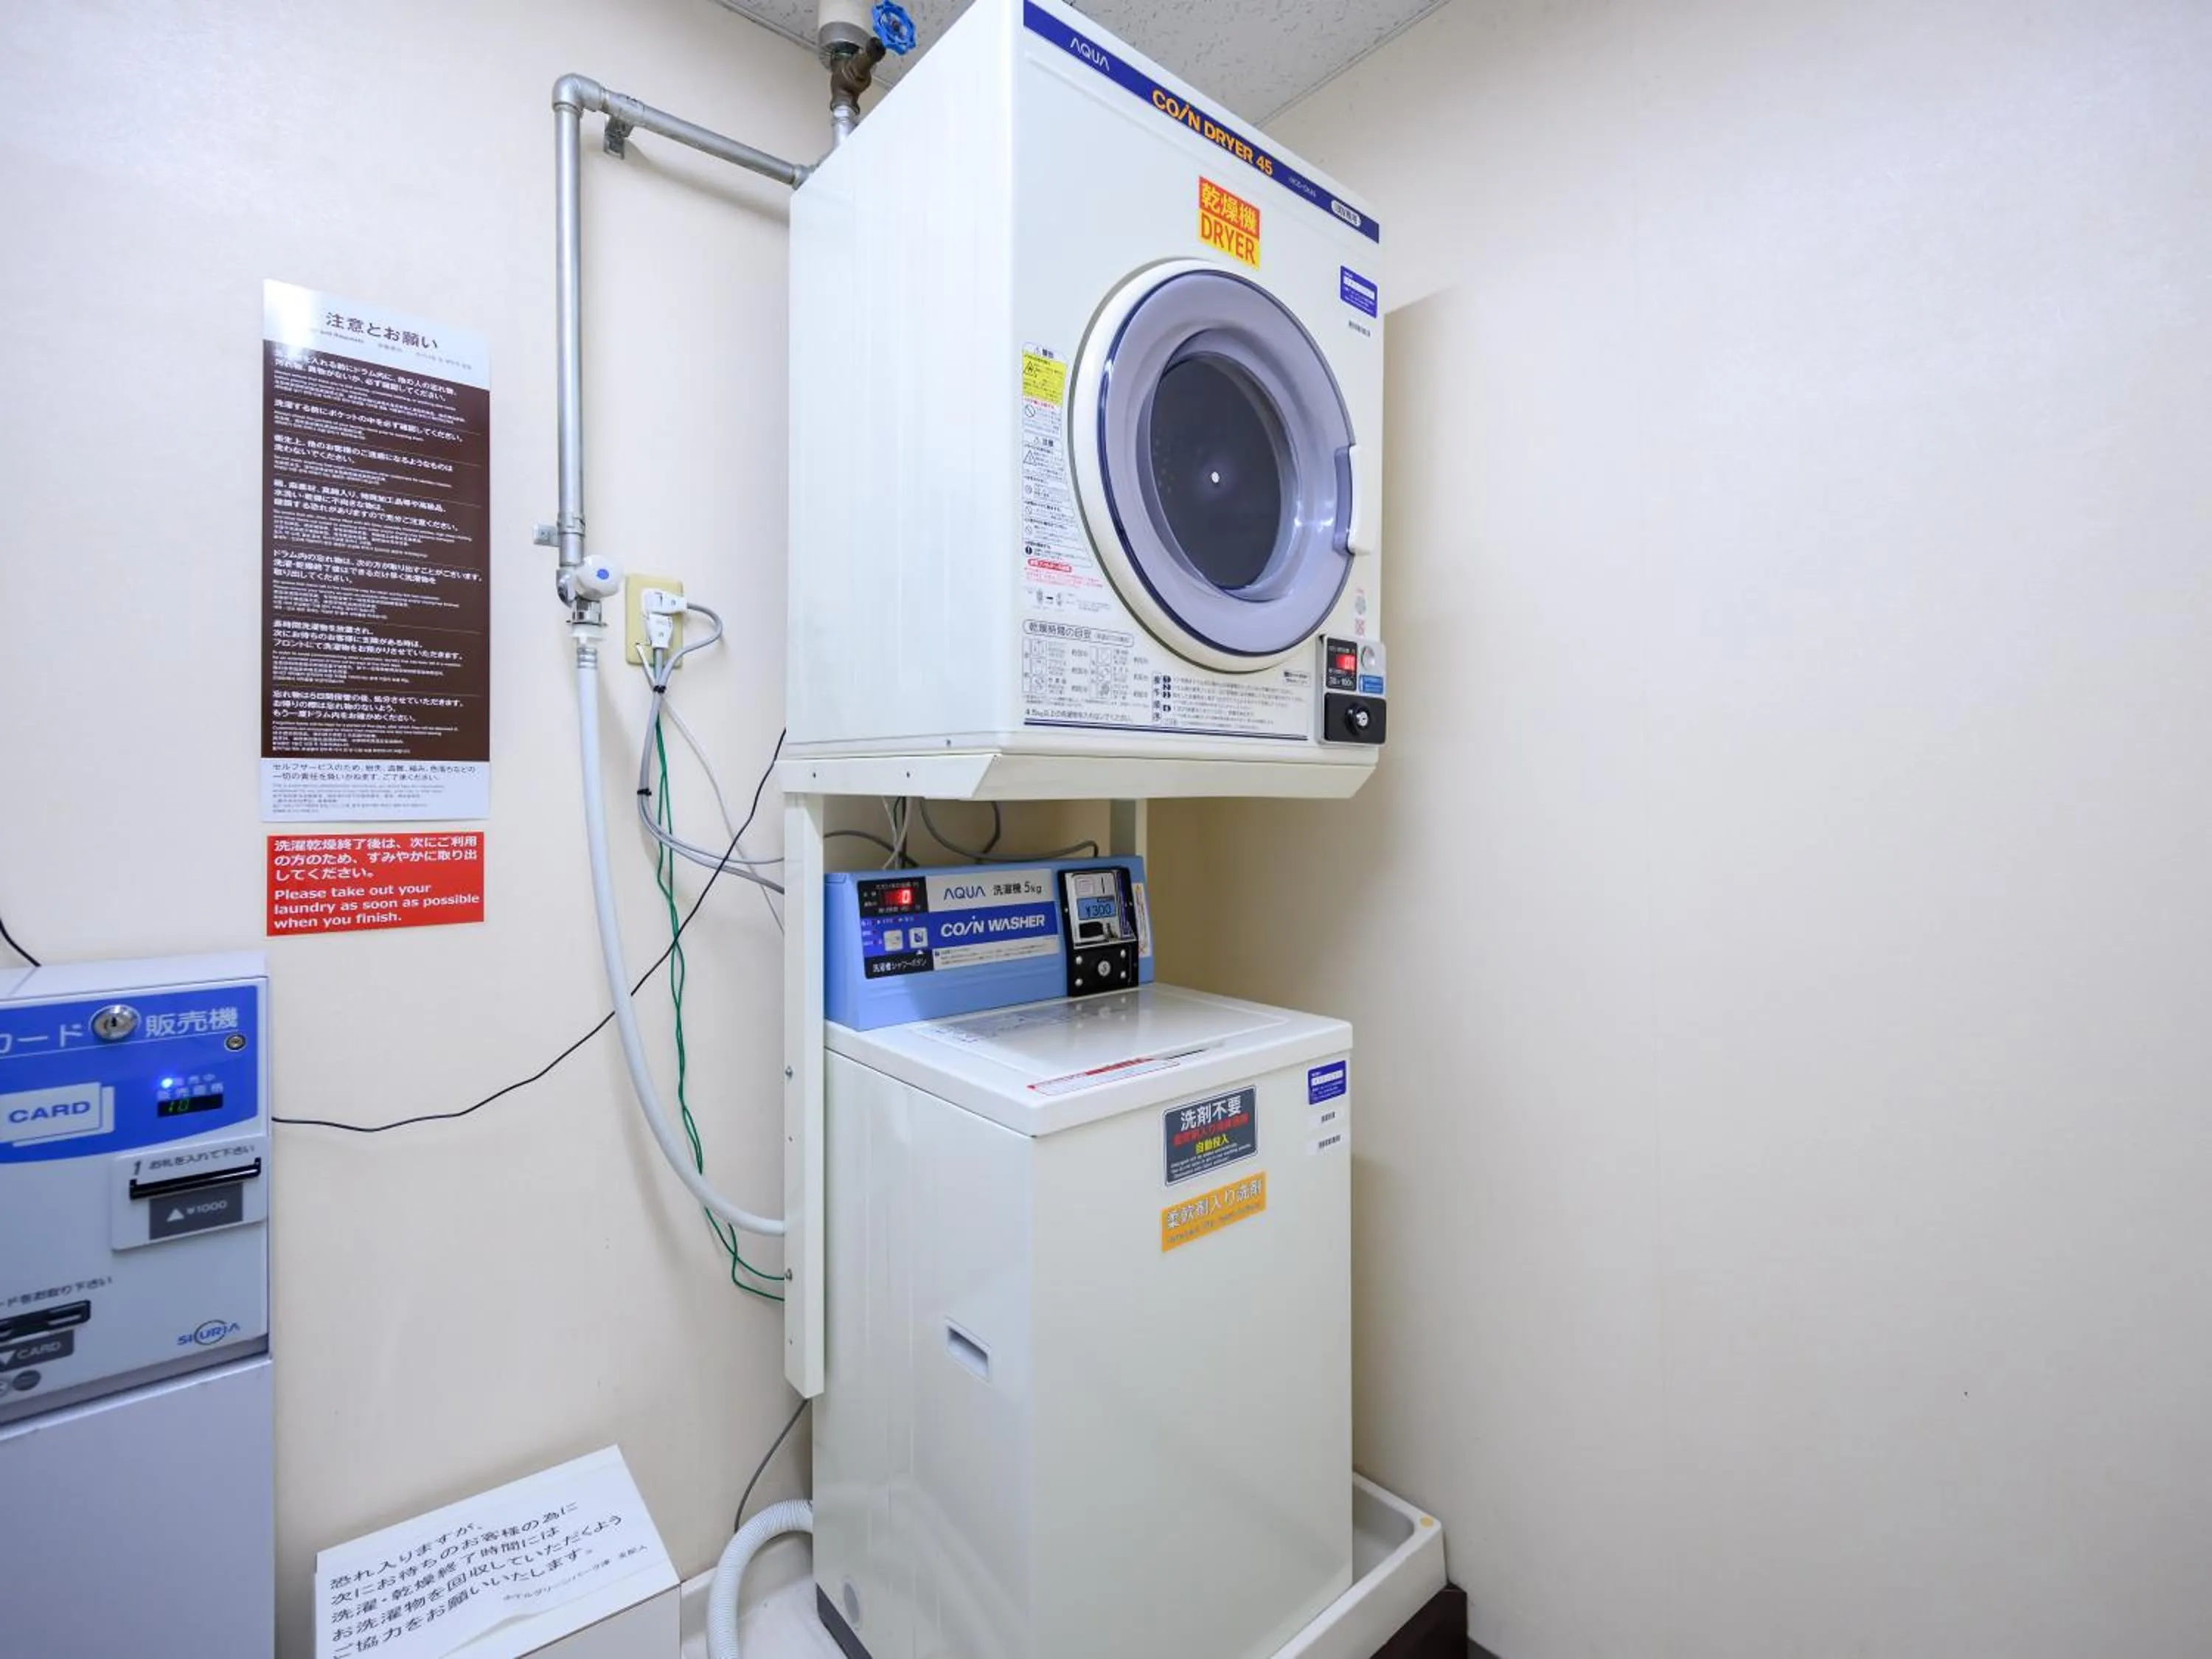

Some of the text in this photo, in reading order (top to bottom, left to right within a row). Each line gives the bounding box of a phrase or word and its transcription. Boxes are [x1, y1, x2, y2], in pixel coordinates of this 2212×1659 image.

[1070, 38, 1110, 72] AQUA
[1152, 88, 1274, 176] COIN DRYER 45
[1202, 181, 1257, 234] 乾燥機
[1200, 212, 1256, 265] DRYER
[325, 312, 439, 349] 注意とお願い
[274, 835, 477, 852] 洗濯乾燥終了後は、次にご利用
[274, 849, 478, 866] の方のため、すみやかに取り出
[276, 867, 375, 882] してください。
[274, 884, 431, 900] Please take out your
[943, 880, 1043, 900] AQUA 洗濯機 5kg
[274, 893, 480, 916] laundry as soon as possible
[274, 912, 402, 929] when you finish.
[941, 915, 985, 938] COIN
[987, 914, 1046, 933] WASHER
[145, 1006, 239, 1037] 販売機
[9, 1101, 91, 1123] CARD
[1180, 1094, 1242, 1133] 洗剤不要
[1194, 1133, 1231, 1155] 自動投入
[133, 1159, 142, 1176] 1
[16, 1340, 62, 1360] CARD
[330, 1500, 579, 1606] 次にお待ちのお客様の為に
[330, 1521, 483, 1590] 恐れ入りますが、
[331, 1526, 560, 1624] 洗濯・乾燥終了時間には
[332, 1514, 623, 1642] お洗濯物を回収していただくよう
[332, 1548, 594, 1659] ご協力をお願いいたします。
